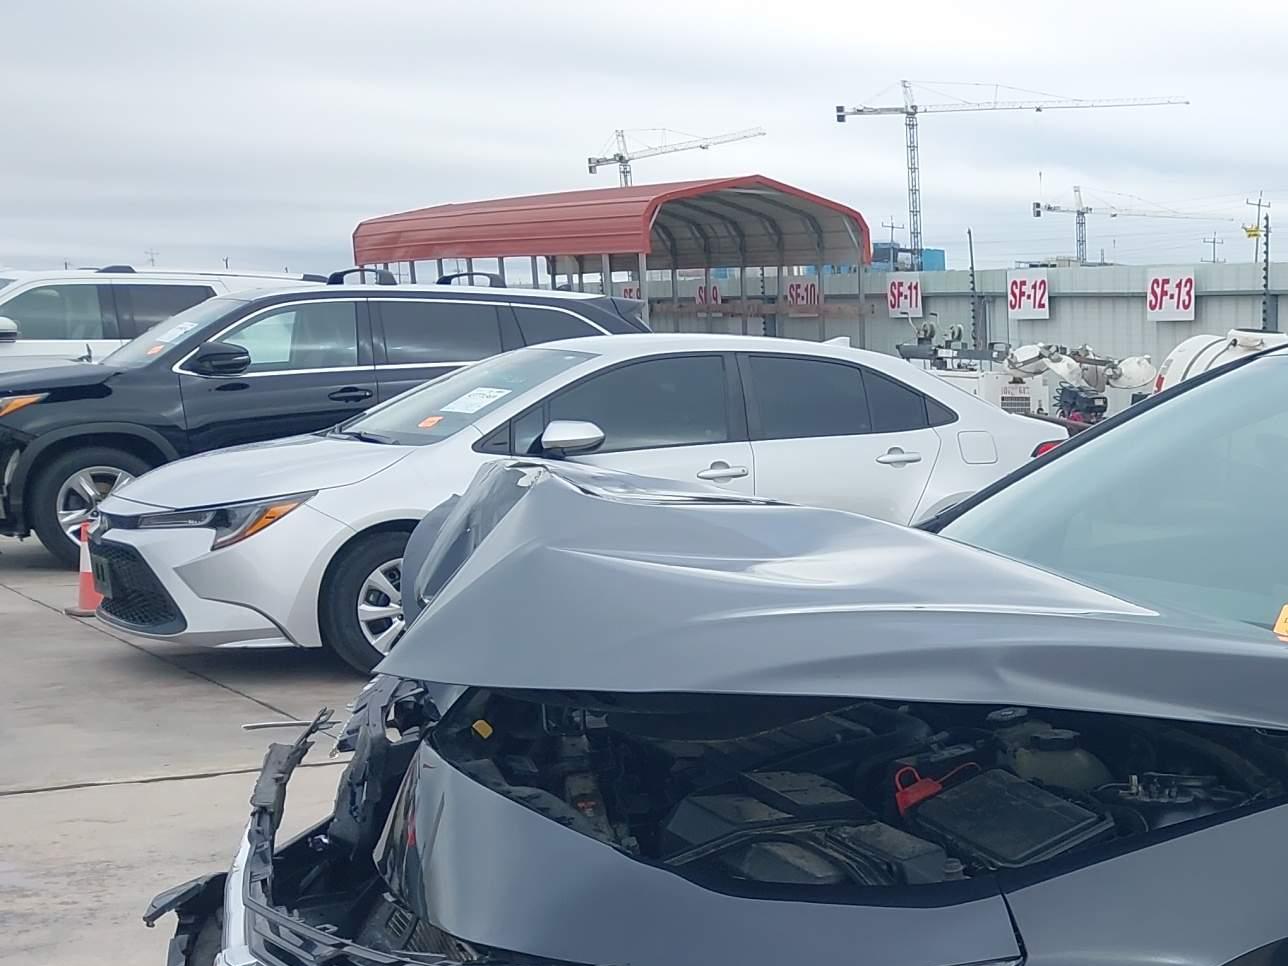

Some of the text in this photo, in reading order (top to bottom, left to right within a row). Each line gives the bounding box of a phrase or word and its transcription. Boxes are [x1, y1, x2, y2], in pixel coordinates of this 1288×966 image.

[889, 280, 919, 310] SF-11
[1009, 279, 1047, 310] SF-12
[1148, 277, 1193, 311] SF-13
